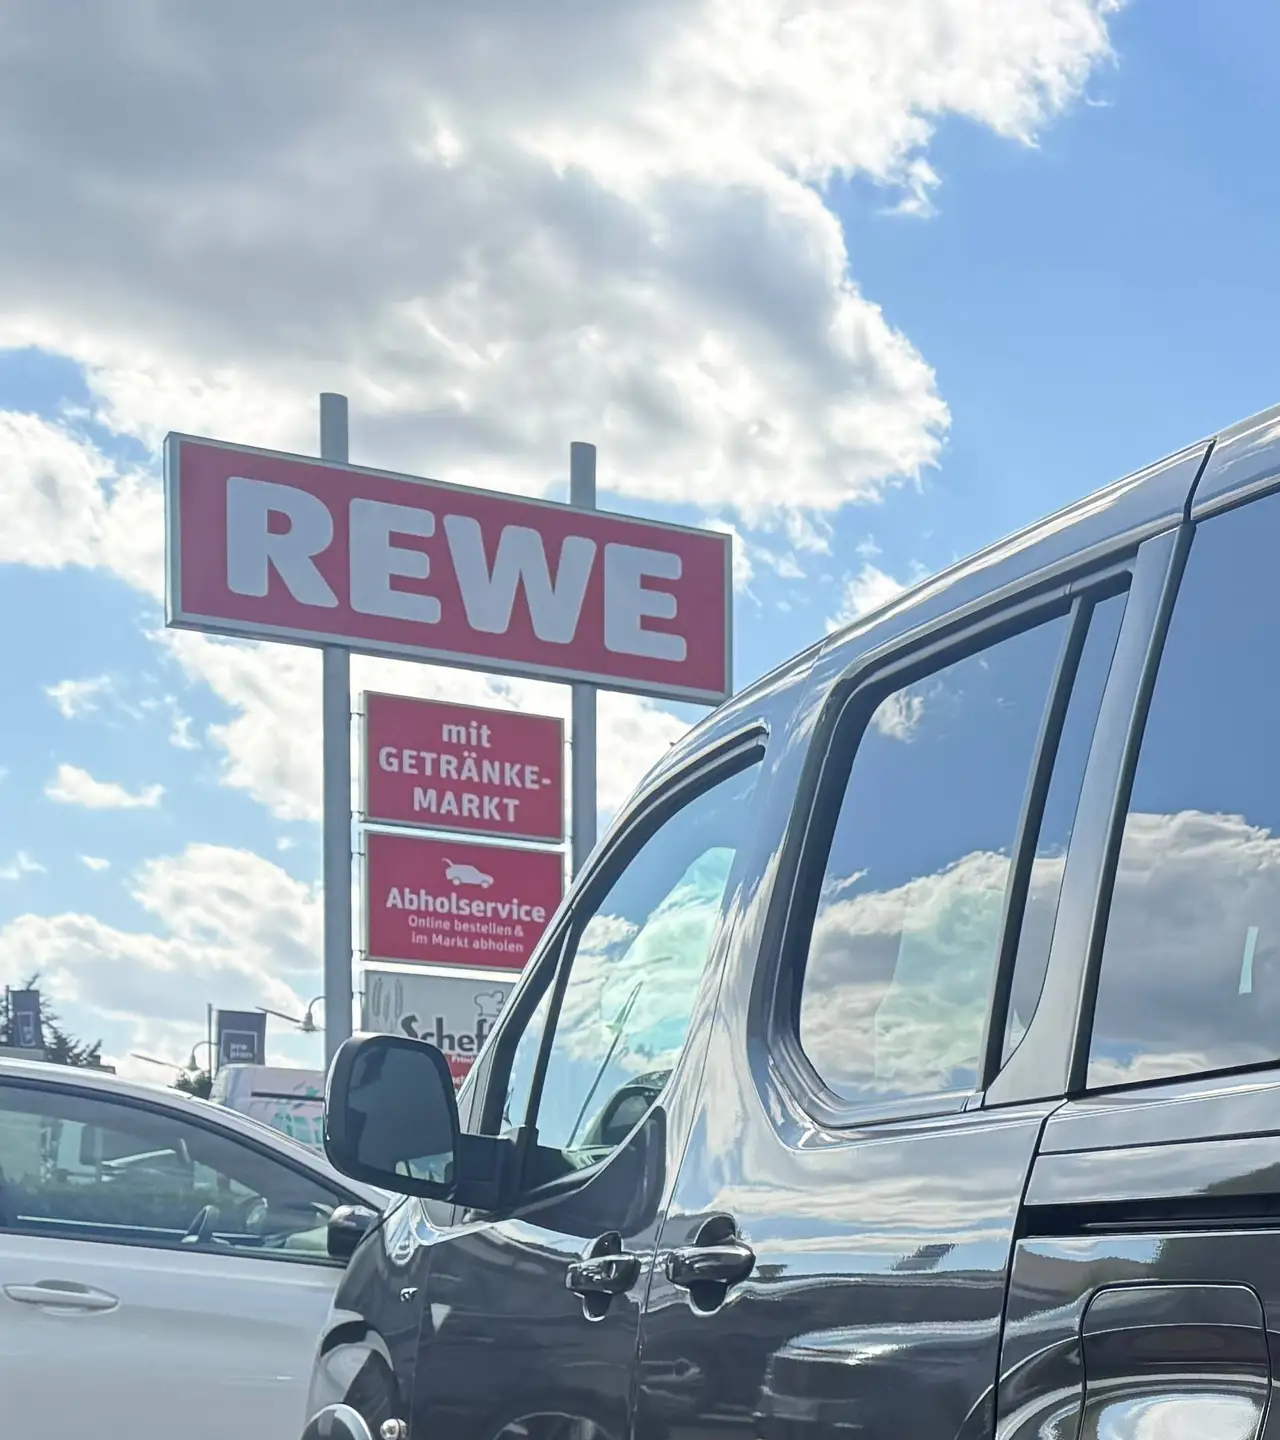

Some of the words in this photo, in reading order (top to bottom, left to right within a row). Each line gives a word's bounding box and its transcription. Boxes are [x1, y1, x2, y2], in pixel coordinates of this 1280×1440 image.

[226, 476, 688, 662] REWE
[441, 720, 492, 748] mit
[378, 746, 552, 790] GETRÄNKE-
[413, 786, 520, 823] MARKT
[386, 887, 546, 923] Abholservice
[408, 915, 451, 931] Online
[454, 918, 512, 937] bestellen
[514, 925, 524, 937] &
[432, 933, 469, 949] Markt
[473, 936, 524, 954] abholen
